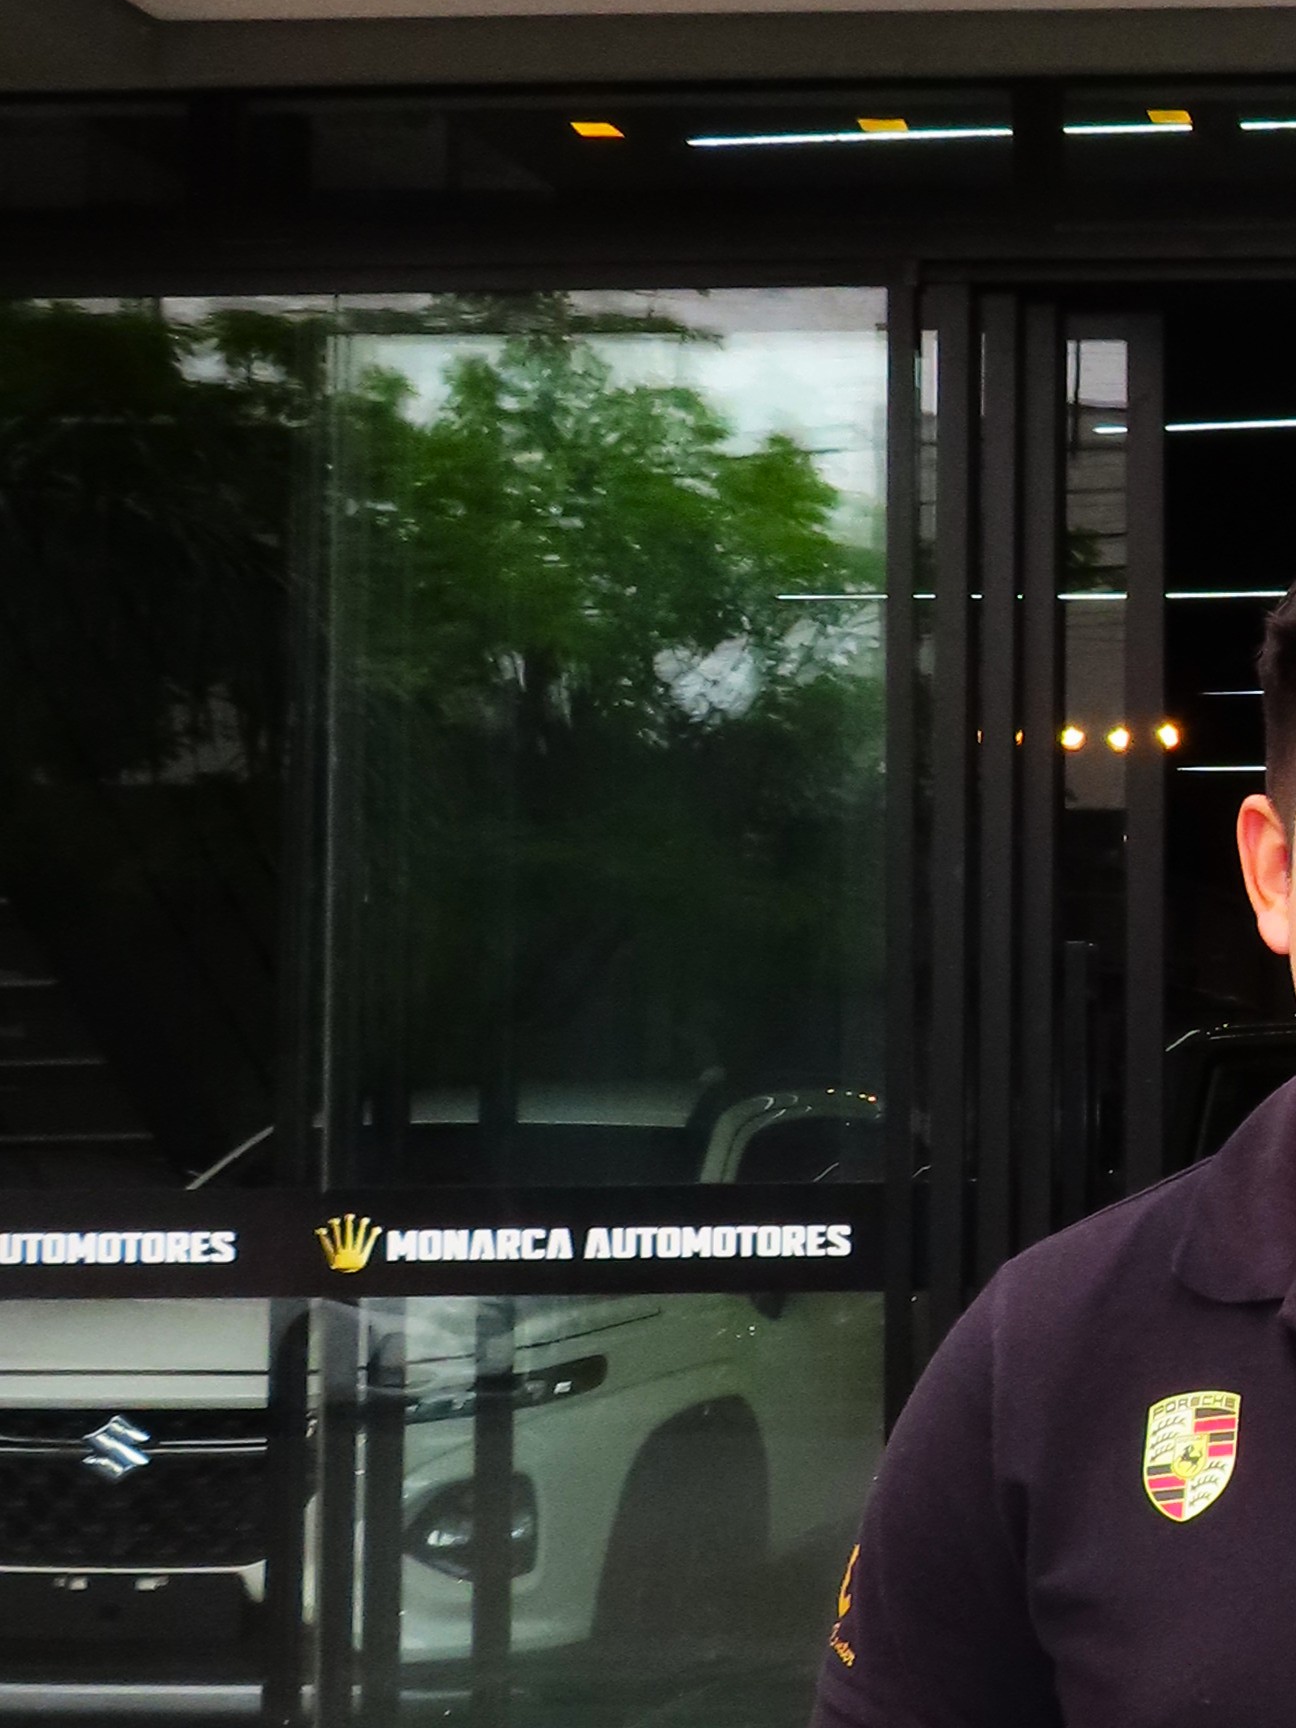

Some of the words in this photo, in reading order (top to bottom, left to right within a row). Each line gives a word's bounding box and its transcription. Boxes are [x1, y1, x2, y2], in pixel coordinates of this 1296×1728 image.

[0, 1230, 236, 1265] UTOMOTORES
[386, 1227, 574, 1262] MONARCA
[583, 1224, 852, 1260] AUTOMOTORES
